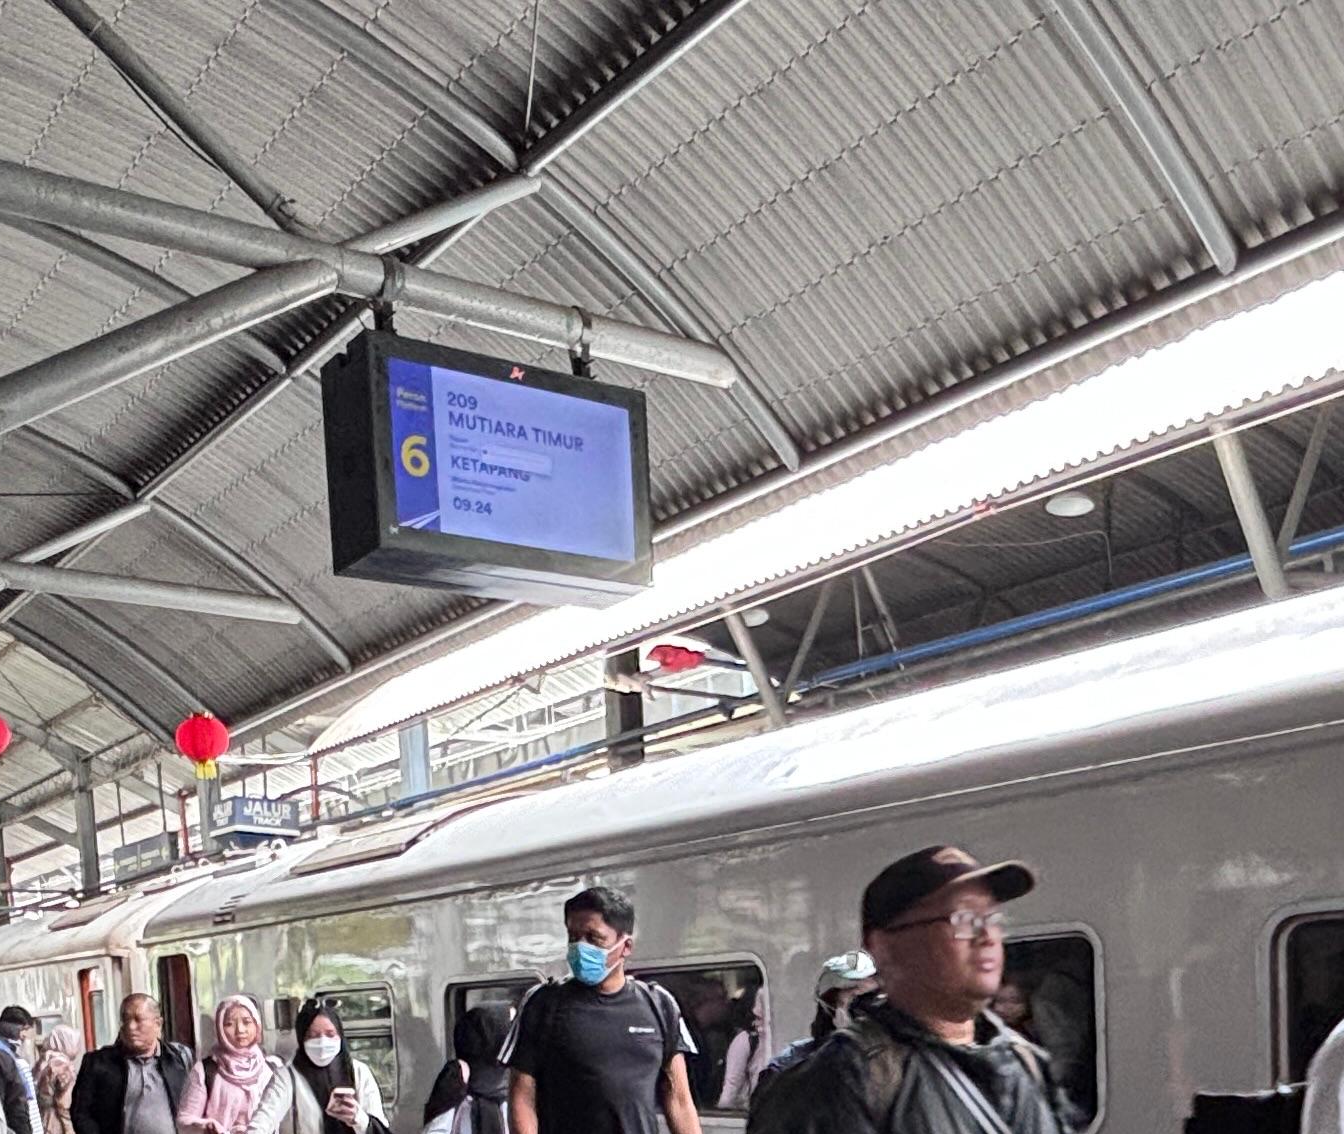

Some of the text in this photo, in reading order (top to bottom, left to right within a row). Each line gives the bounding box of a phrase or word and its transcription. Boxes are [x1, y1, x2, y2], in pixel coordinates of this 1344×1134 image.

[447, 391, 478, 410] 209
[448, 411, 584, 452] MUTIARA TIMUR
[400, 434, 430, 478] 6
[452, 495, 493, 515] 09.24
[242, 800, 292, 820] JALUR
[253, 816, 283, 827] TRACK
